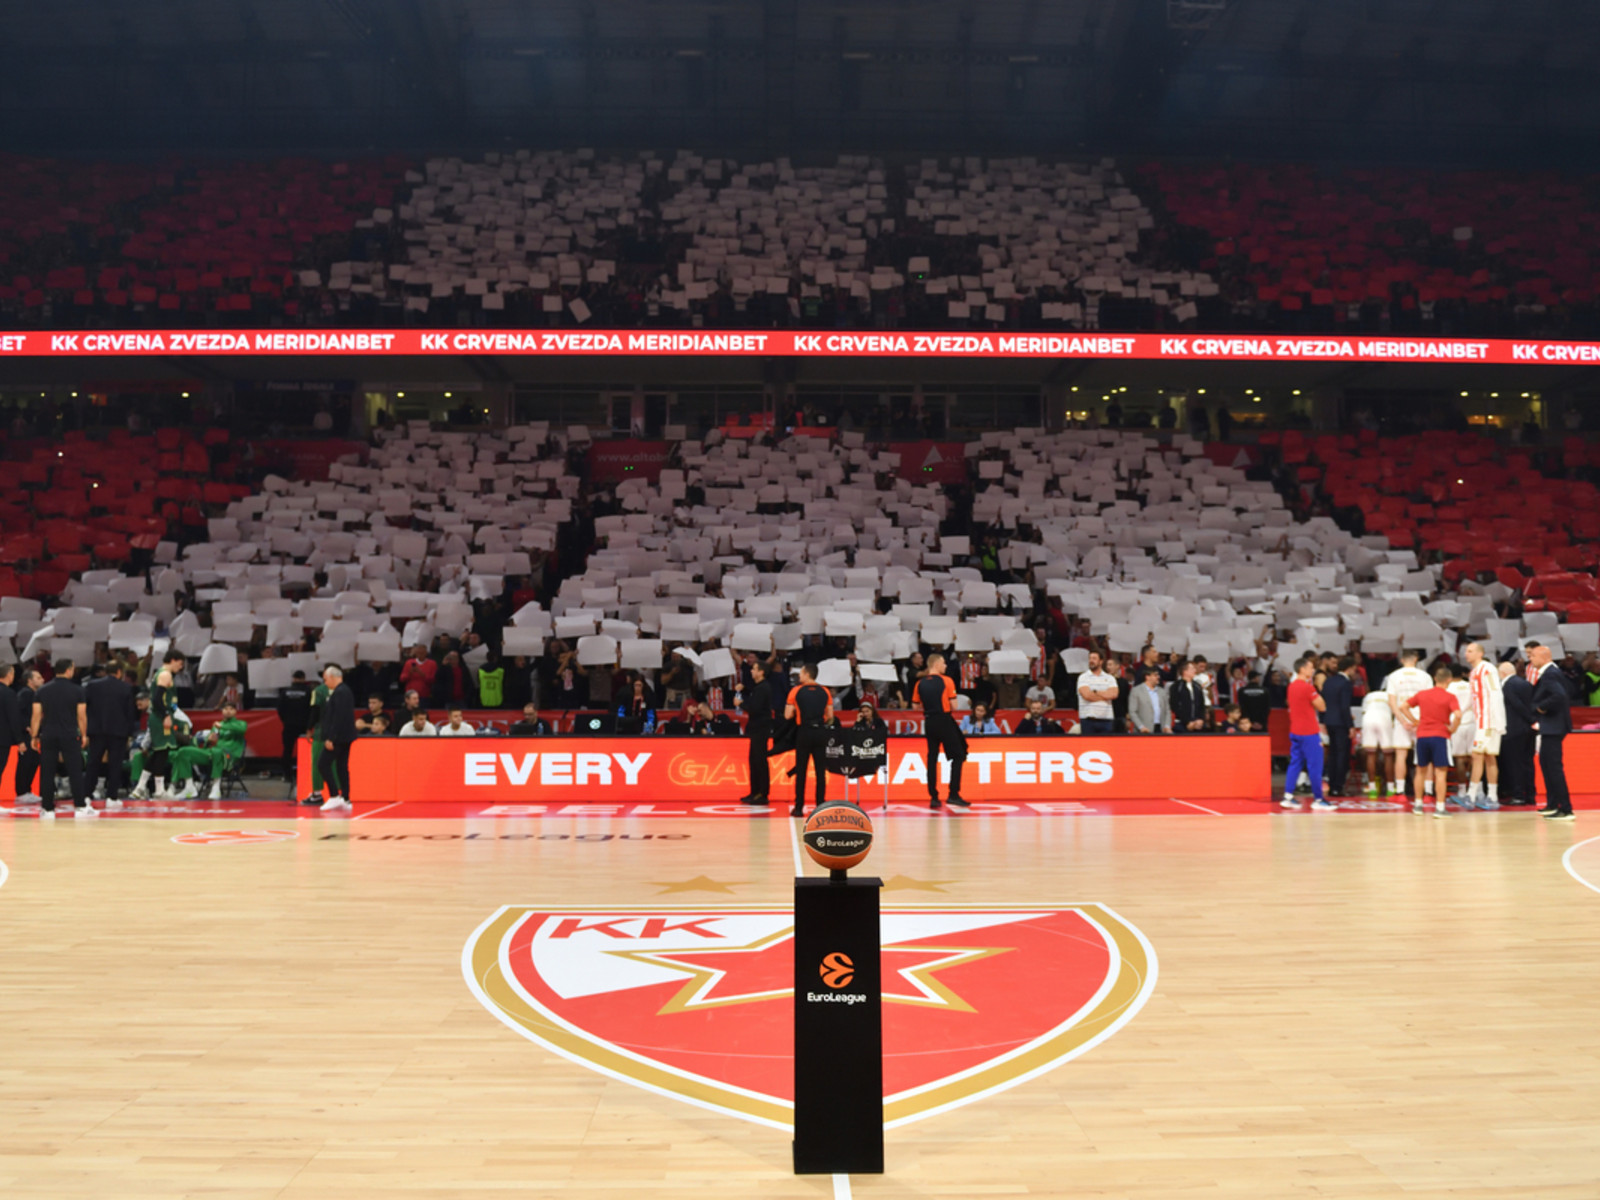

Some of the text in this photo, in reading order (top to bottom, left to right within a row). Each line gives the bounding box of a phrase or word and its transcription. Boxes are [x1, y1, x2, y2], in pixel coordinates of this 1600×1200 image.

[0, 335, 26, 350] ET
[52, 335, 394, 350] KK CRVENA ZVEZDA MERIDIANBET
[421, 334, 767, 350] KK CRVENA ZVEZDA MERIDIANBET
[795, 336, 1135, 353] KK CRVENA ZVEZDA MERIDIANBET
[1161, 339, 1488, 358] KK CRVENA ZVEZDA MERIDIANBET
[1512, 344, 1539, 360] KK
[465, 753, 651, 786] EVERY
[815, 814, 864, 829] SPALDING
[548, 918, 728, 938] KK
[807, 992, 867, 1005] EuroLeague
